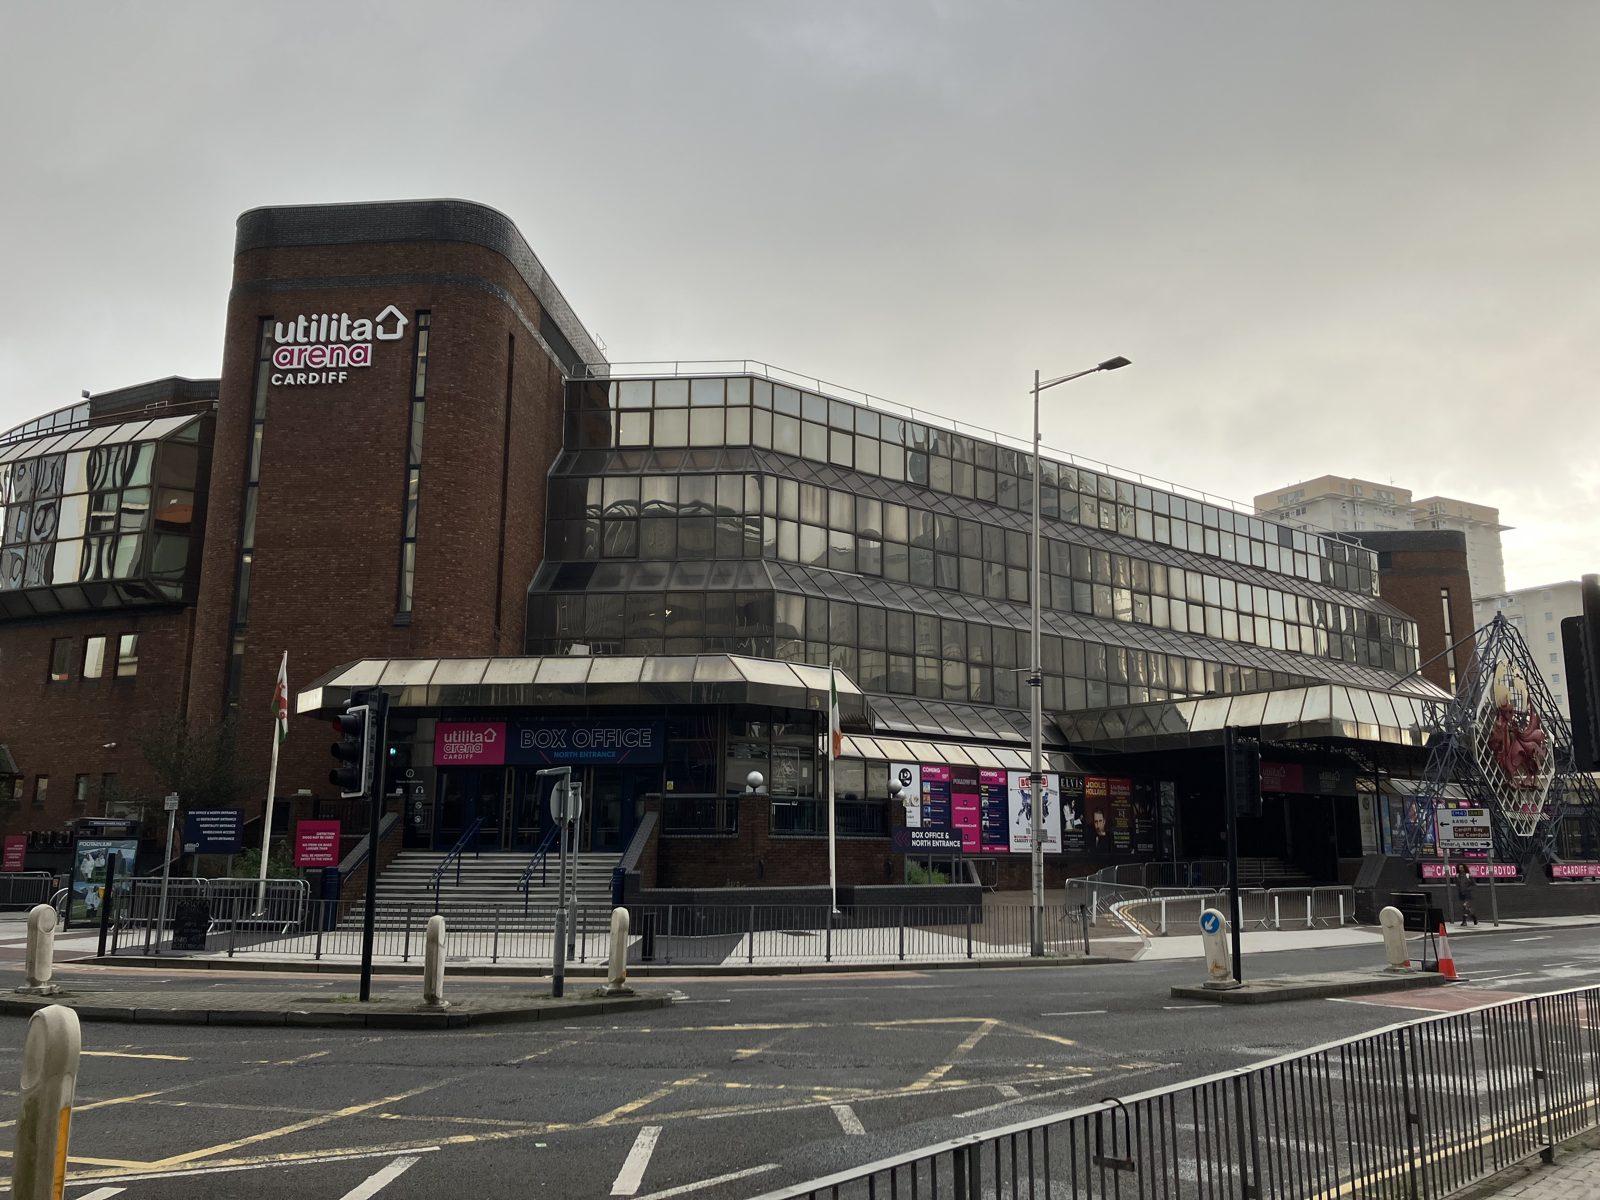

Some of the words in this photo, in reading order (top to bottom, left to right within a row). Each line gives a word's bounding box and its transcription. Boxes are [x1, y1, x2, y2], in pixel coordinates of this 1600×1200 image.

[274, 313, 373, 343] utilita
[272, 343, 372, 370] arena
[271, 371, 348, 386] CARDIFF
[444, 730, 483, 743] utilita
[520, 729, 567, 748] BOX
[572, 728, 652, 748] OFFICE
[443, 743, 483, 754] arena
[1060, 777, 1083, 788] ELVIS
[911, 831, 924, 839] BOX
[924, 831, 945, 839] OFFICE
[945, 832, 950, 840] &
[931, 840, 961, 848] ENTRANCE
[1480, 865, 1517, 875] CARDYDD
[1562, 865, 1588, 875] CARDIFF
